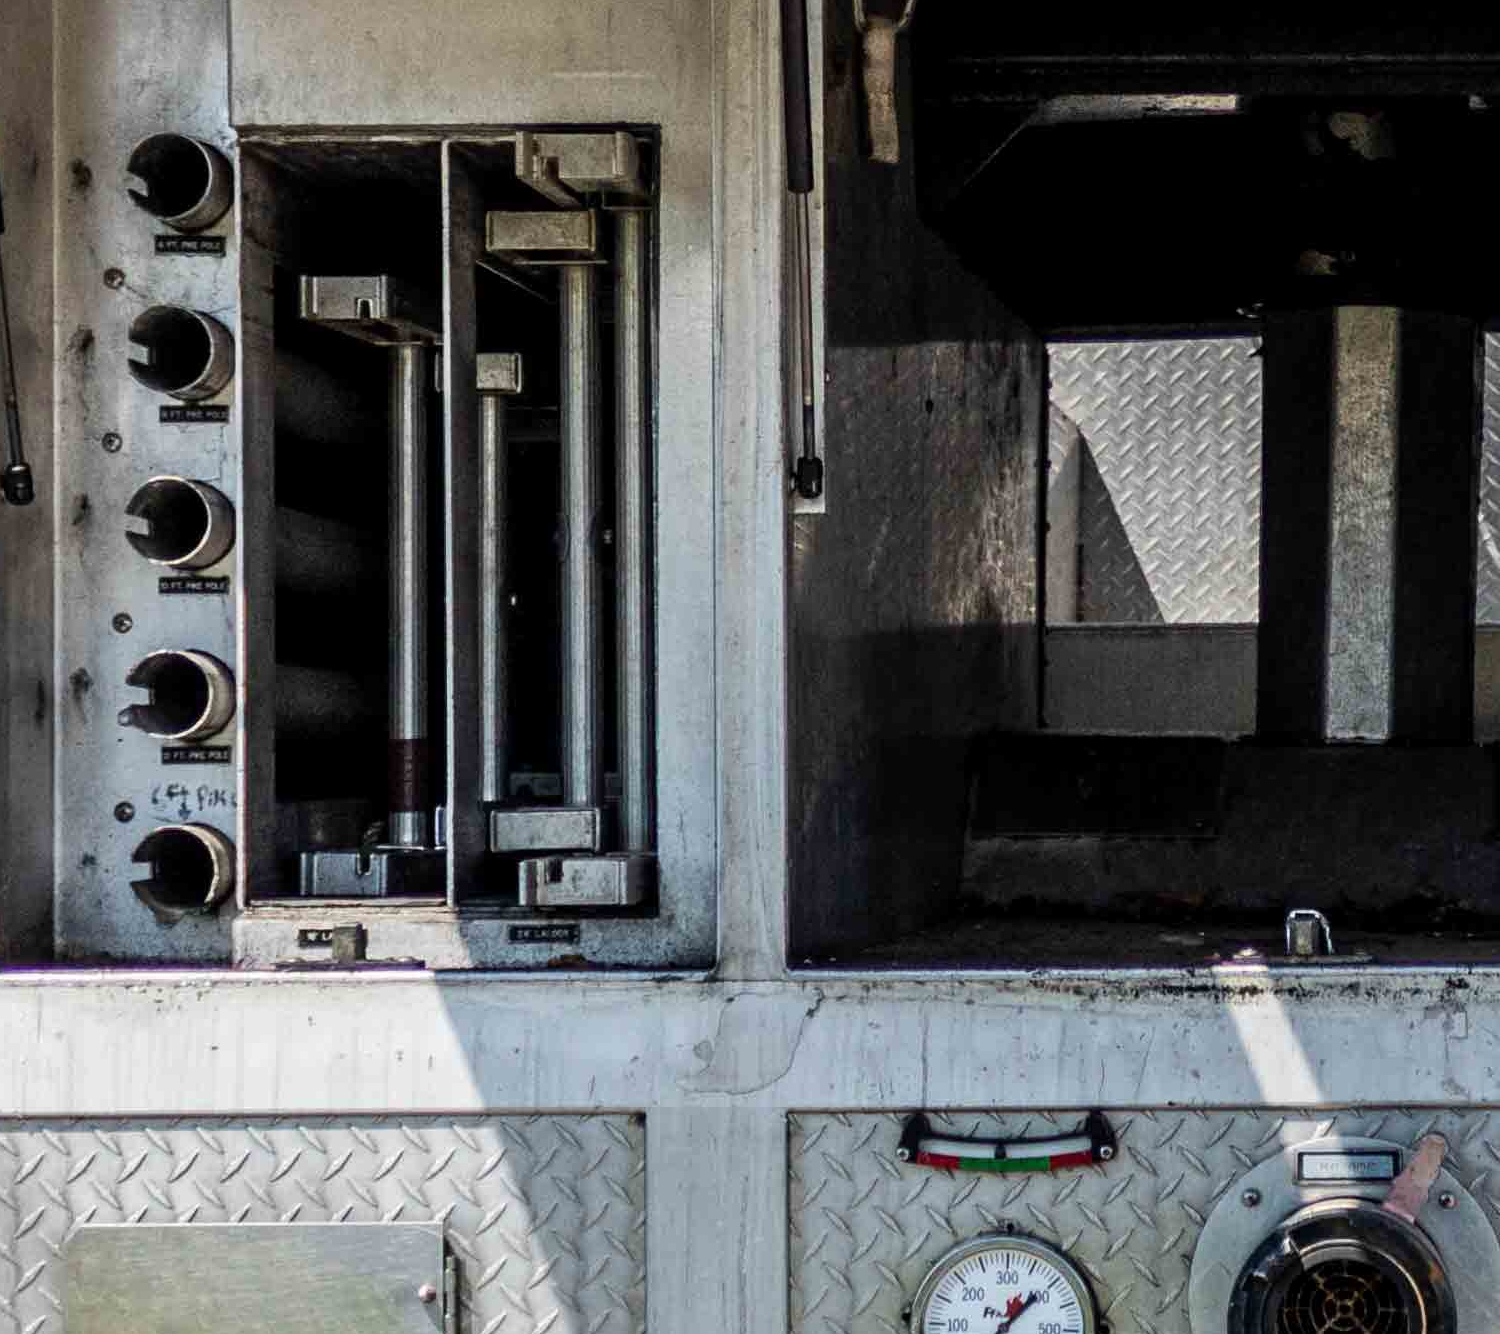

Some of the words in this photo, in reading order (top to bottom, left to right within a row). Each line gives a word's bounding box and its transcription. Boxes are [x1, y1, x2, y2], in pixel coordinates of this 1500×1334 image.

[996, 1270, 1019, 1285] 300
[962, 1287, 985, 1302] 200
[1029, 1290, 1050, 1304] 00
[947, 1318, 968, 1333] 100
